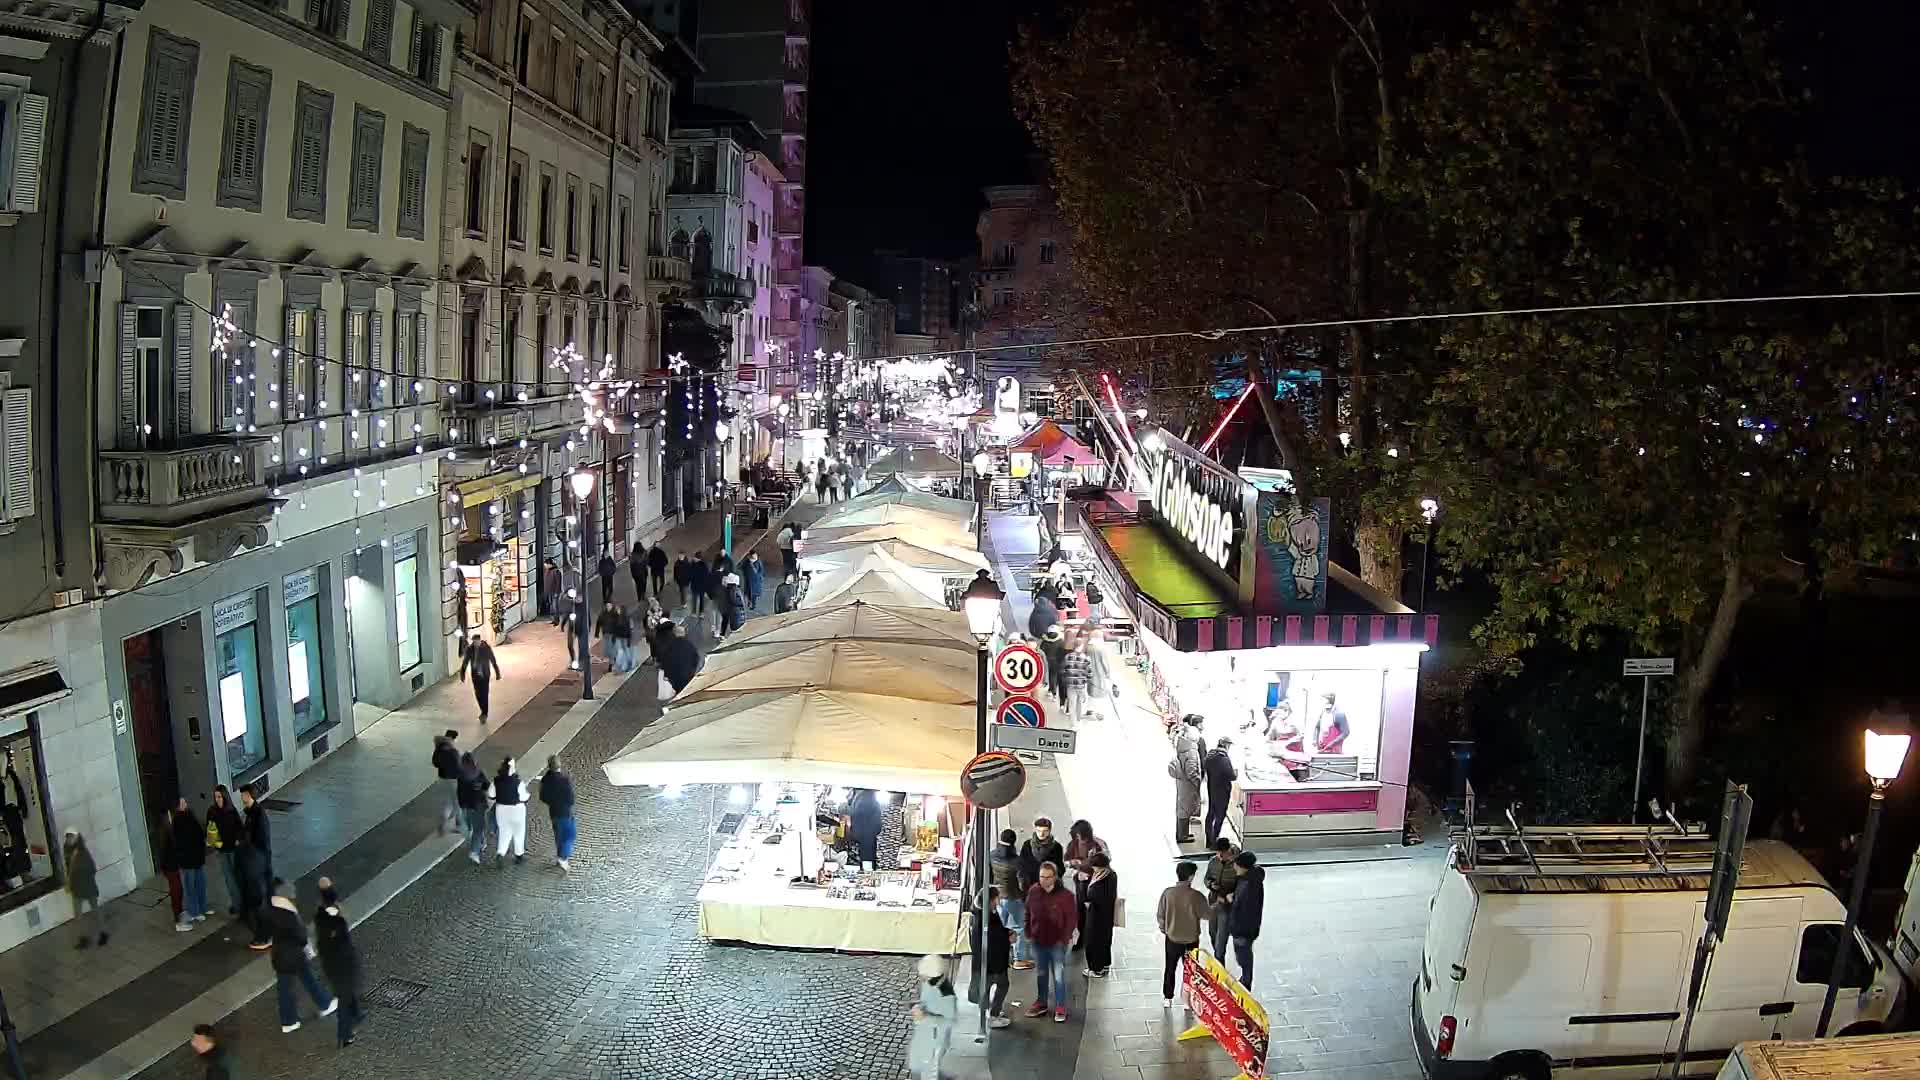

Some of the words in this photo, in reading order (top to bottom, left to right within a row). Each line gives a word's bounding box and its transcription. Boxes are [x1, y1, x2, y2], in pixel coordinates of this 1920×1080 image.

[1162, 458, 1233, 569] Golosone
[1006, 658, 1033, 681] 30
[1038, 737, 1070, 749] Dante
[1230, 1015, 1262, 1052] Calde
